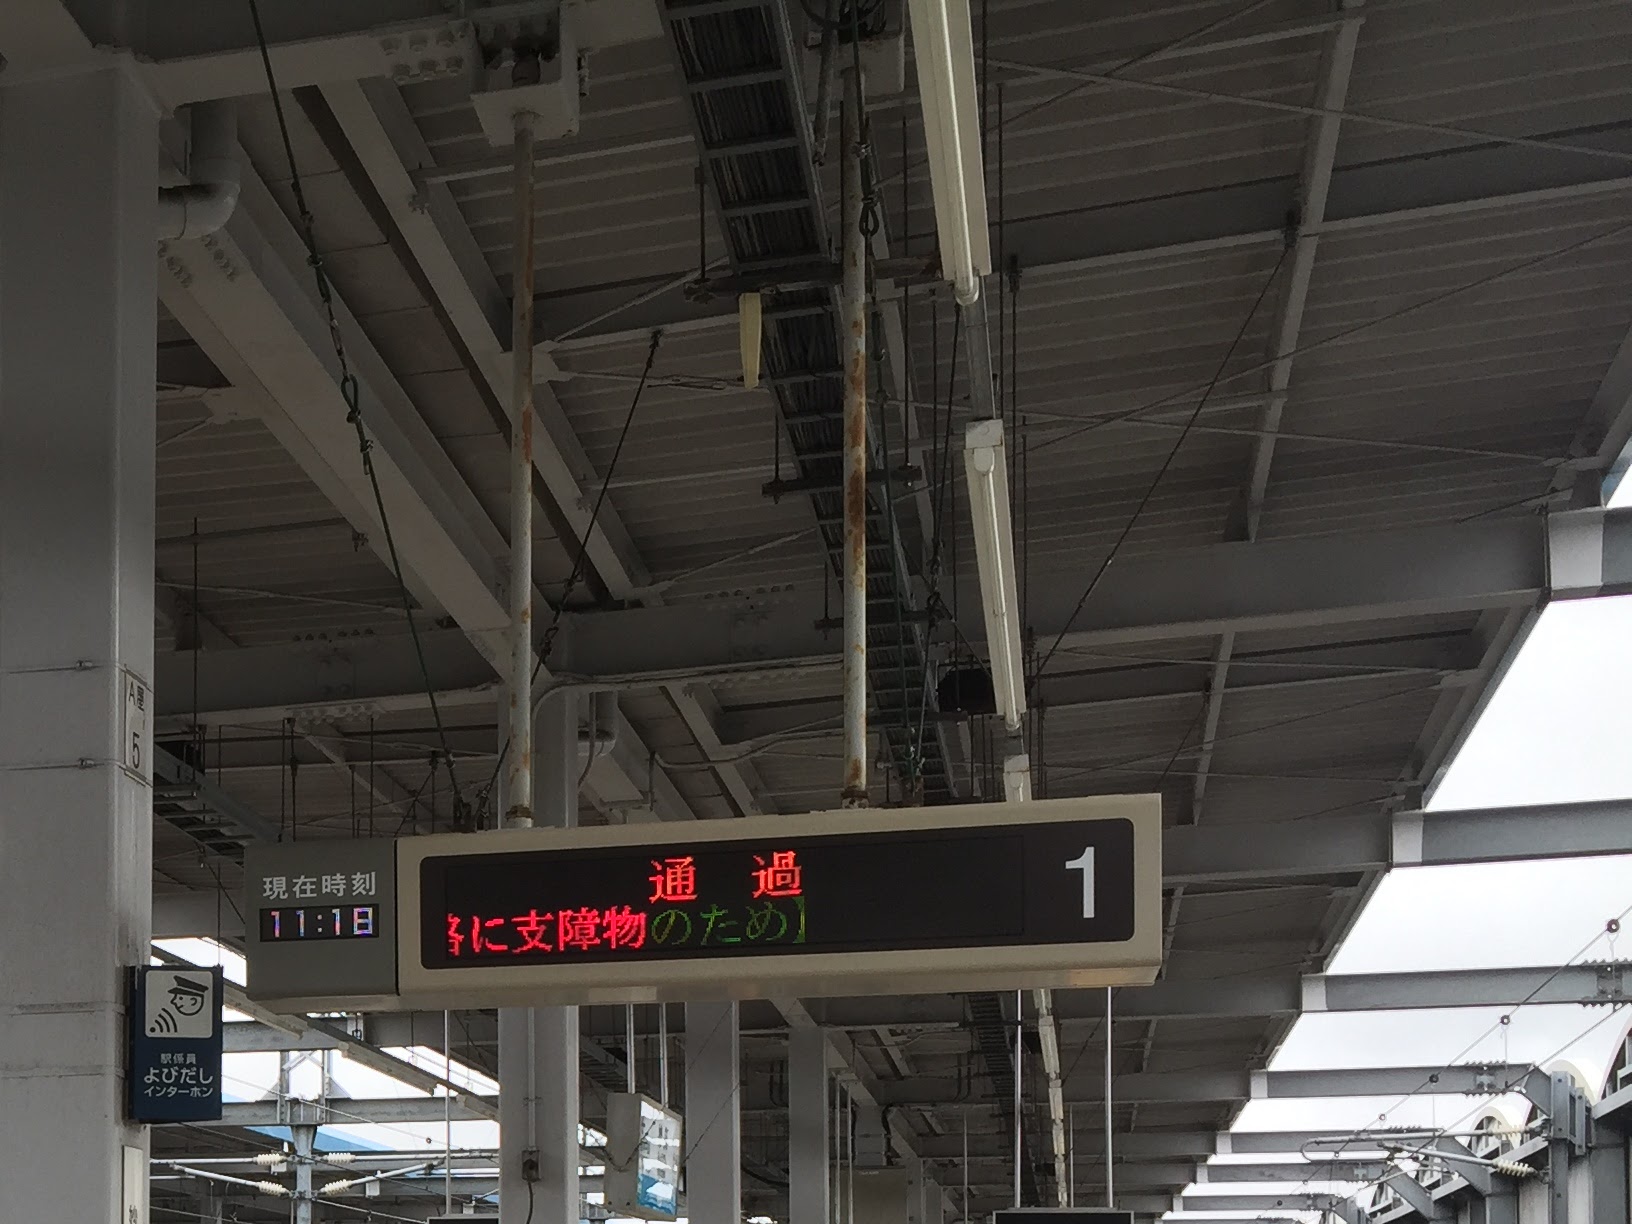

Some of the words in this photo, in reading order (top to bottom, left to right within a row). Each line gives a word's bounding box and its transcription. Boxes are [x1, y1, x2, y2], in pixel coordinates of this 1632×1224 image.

[133, 731, 140, 769] 5
[262, 871, 376, 900] 現在時刻
[1065, 846, 1095, 918] 1
[271, 907, 373, 938] 11:18
[160, 1053, 197, 1065] 駅係員
[144, 1067, 214, 1085] よびだし
[143, 1085, 214, 1098] インターホン
